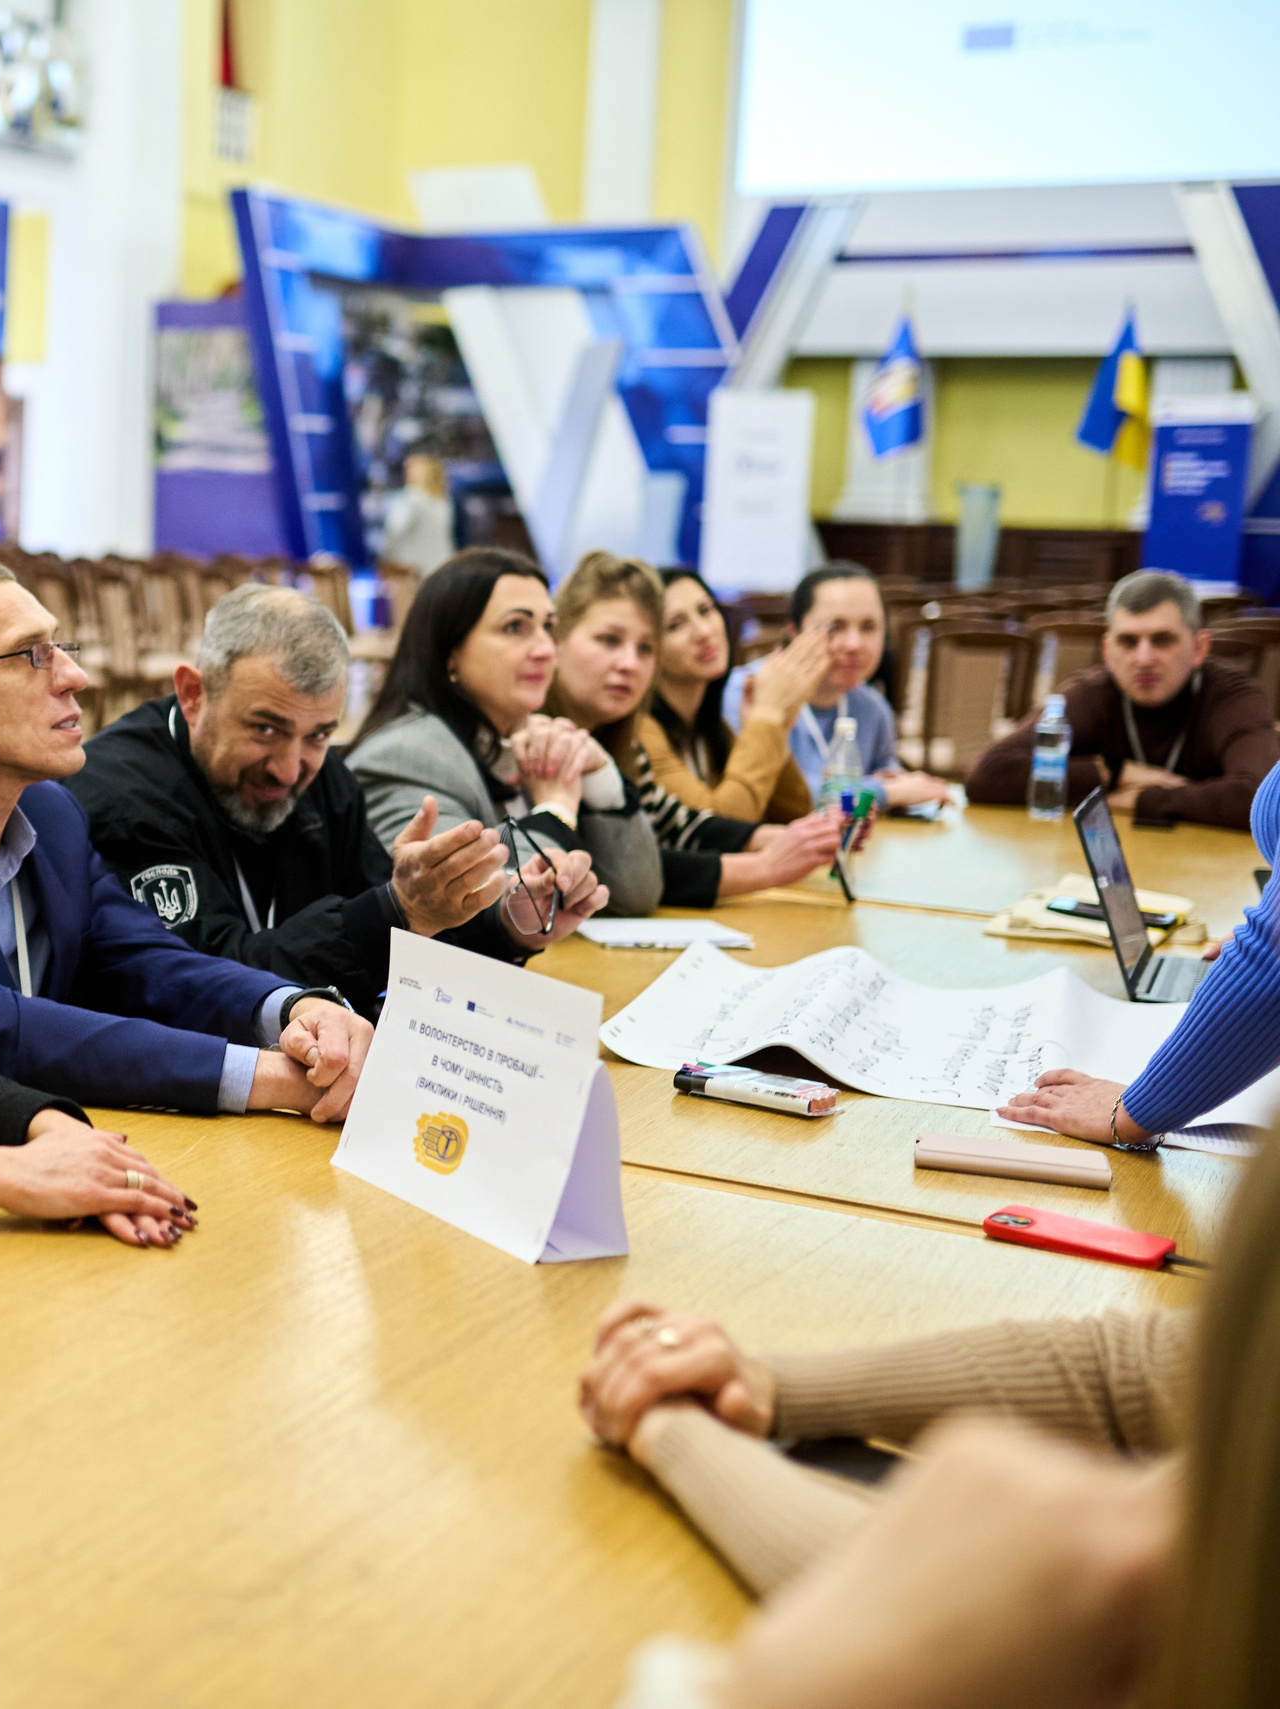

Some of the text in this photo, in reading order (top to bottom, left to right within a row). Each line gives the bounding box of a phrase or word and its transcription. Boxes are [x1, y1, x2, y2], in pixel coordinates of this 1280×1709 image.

[420, 1023, 486, 1058] ВОЛОНТЕРСТВО
[487, 1049, 494, 1061] В
[494, 1052, 539, 1078] ПРОБАЦІЇ
[431, 1055, 503, 1093] В ЧОМУ ЦІННІСТЬ
[416, 1076, 458, 1101] (ВИКЛИКИ
[462, 1095, 507, 1125] РІШЕННЯ)
